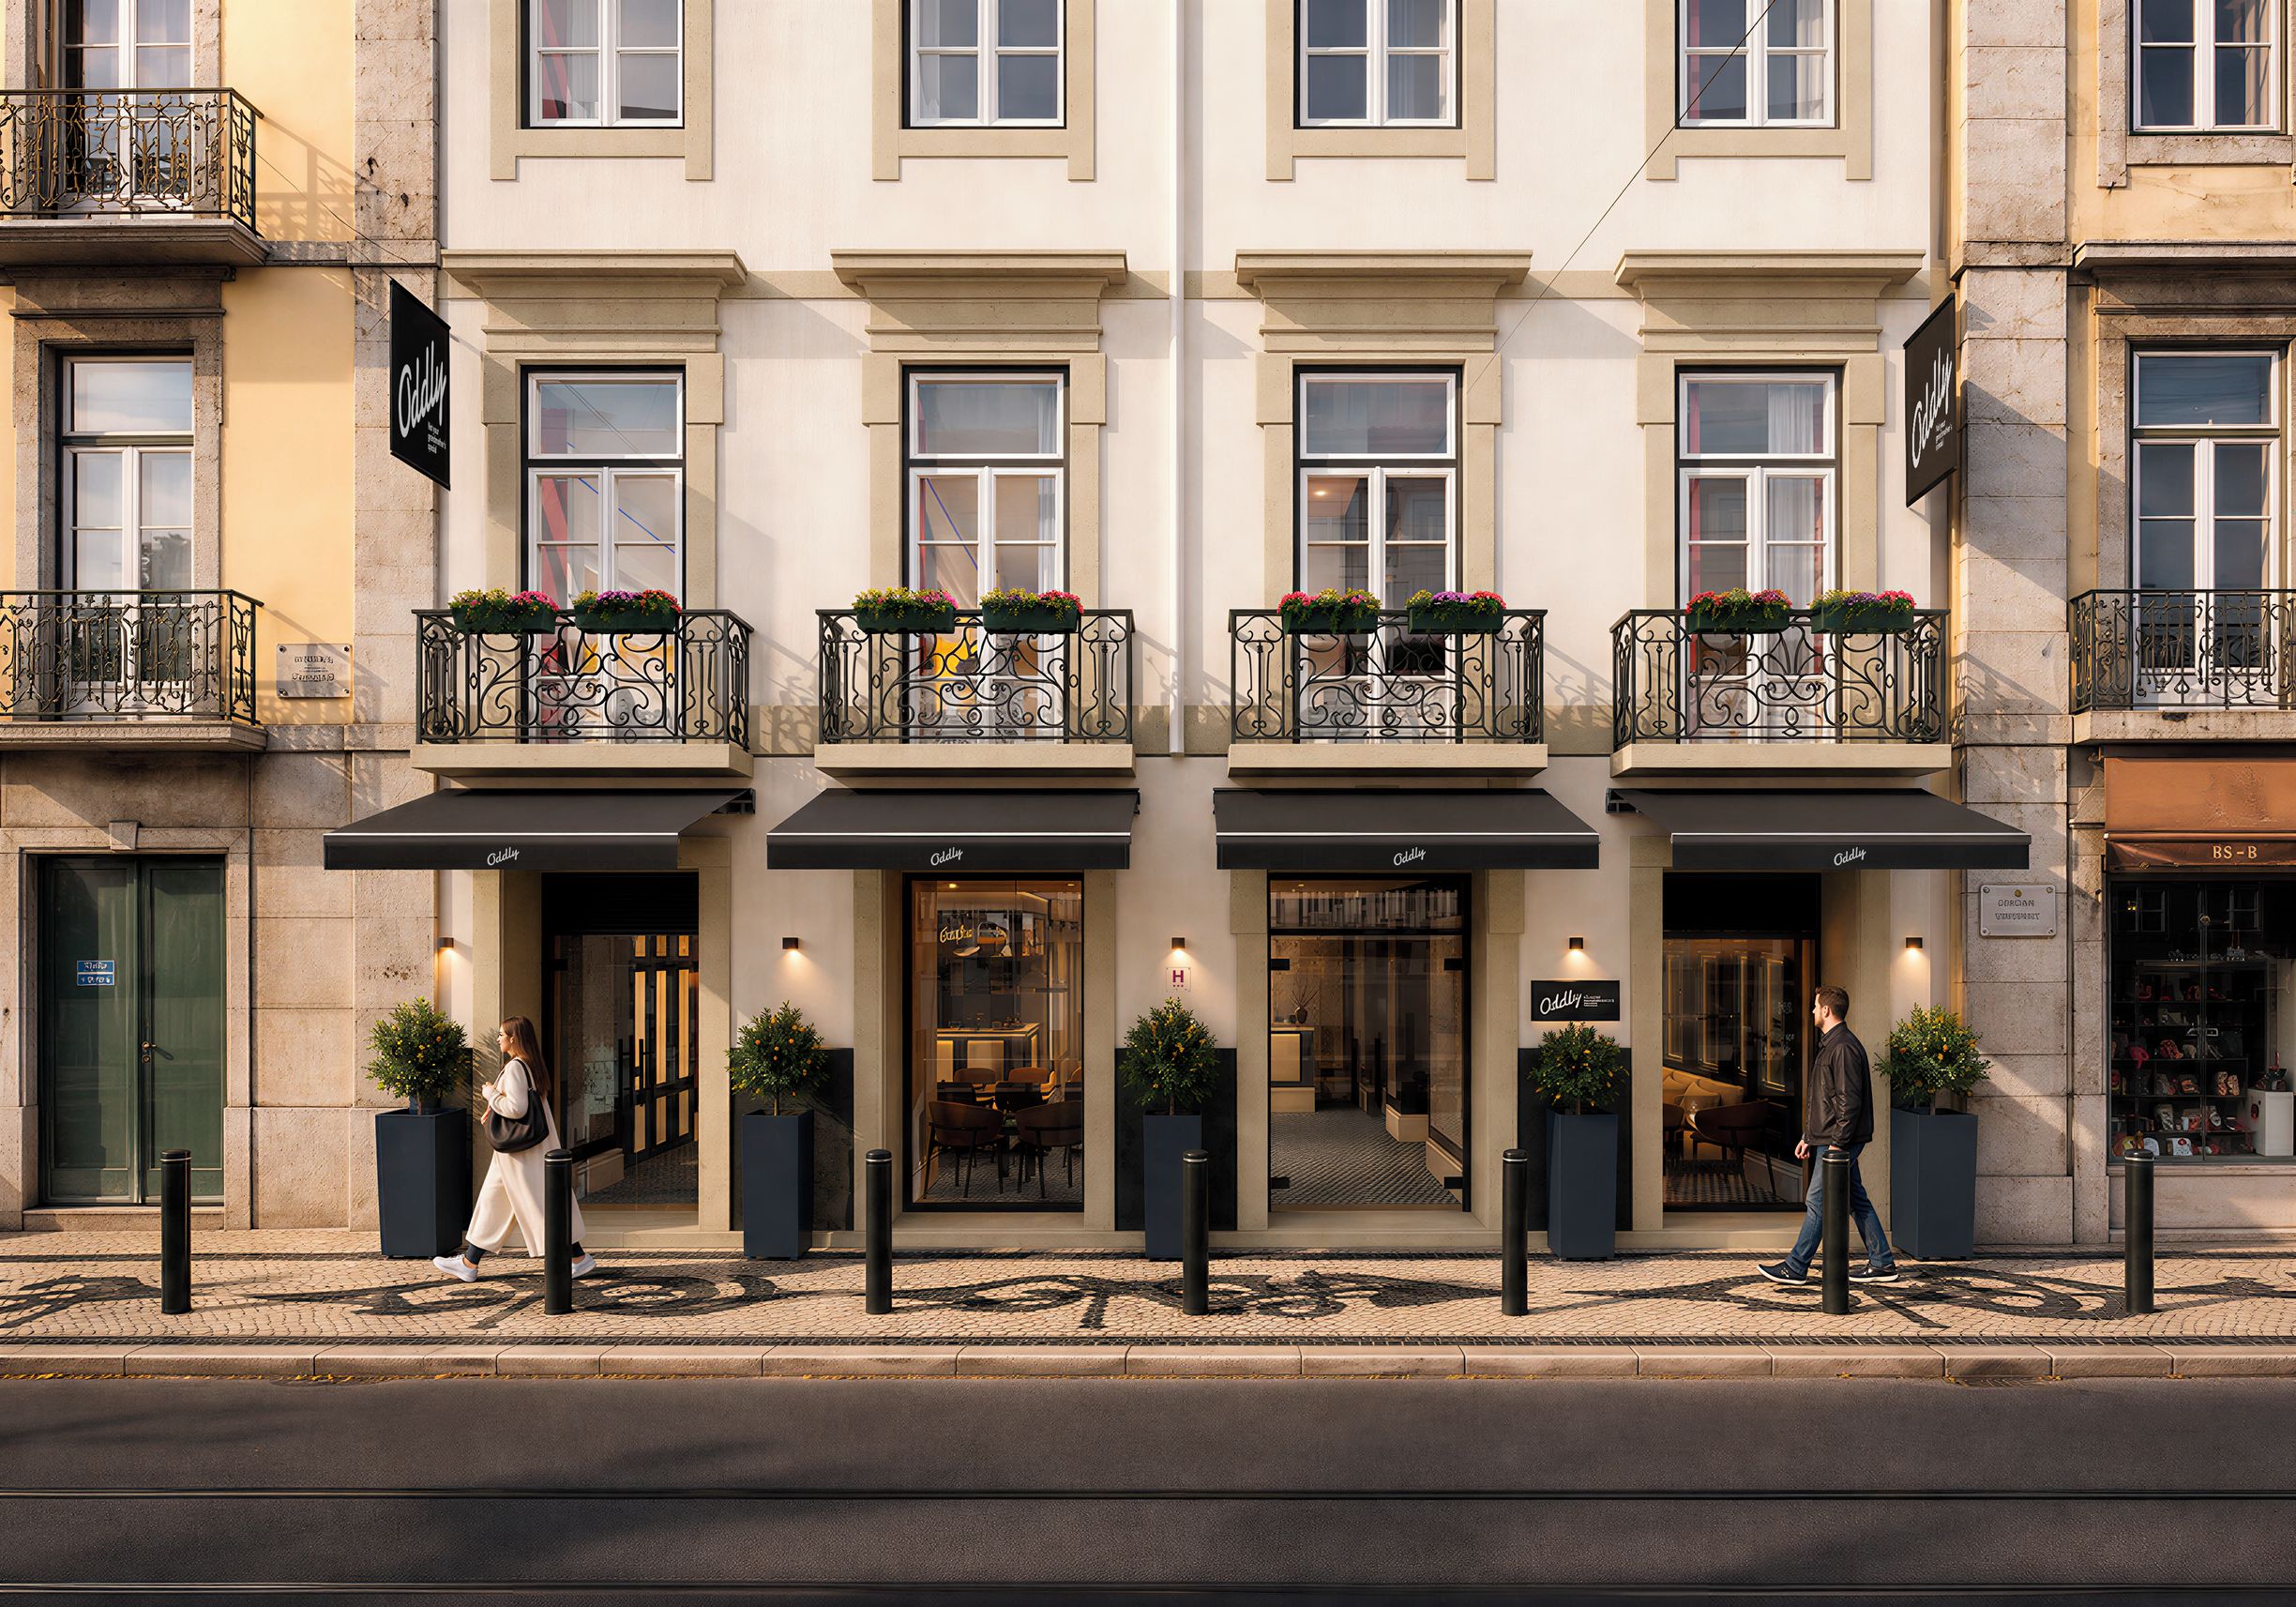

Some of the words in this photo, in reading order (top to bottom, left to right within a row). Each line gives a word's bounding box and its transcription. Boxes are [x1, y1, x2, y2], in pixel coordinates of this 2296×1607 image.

[399, 340, 446, 438] Oddly
[1911, 346, 1953, 469] Oddly
[487, 846, 520, 866] Oddly
[930, 846, 963, 866] Oddly
[1393, 846, 1427, 866] Oddly
[1834, 846, 1866, 866] Oddly
[1172, 970, 1184, 983] H
[1539, 989, 1582, 1015] Oddly
